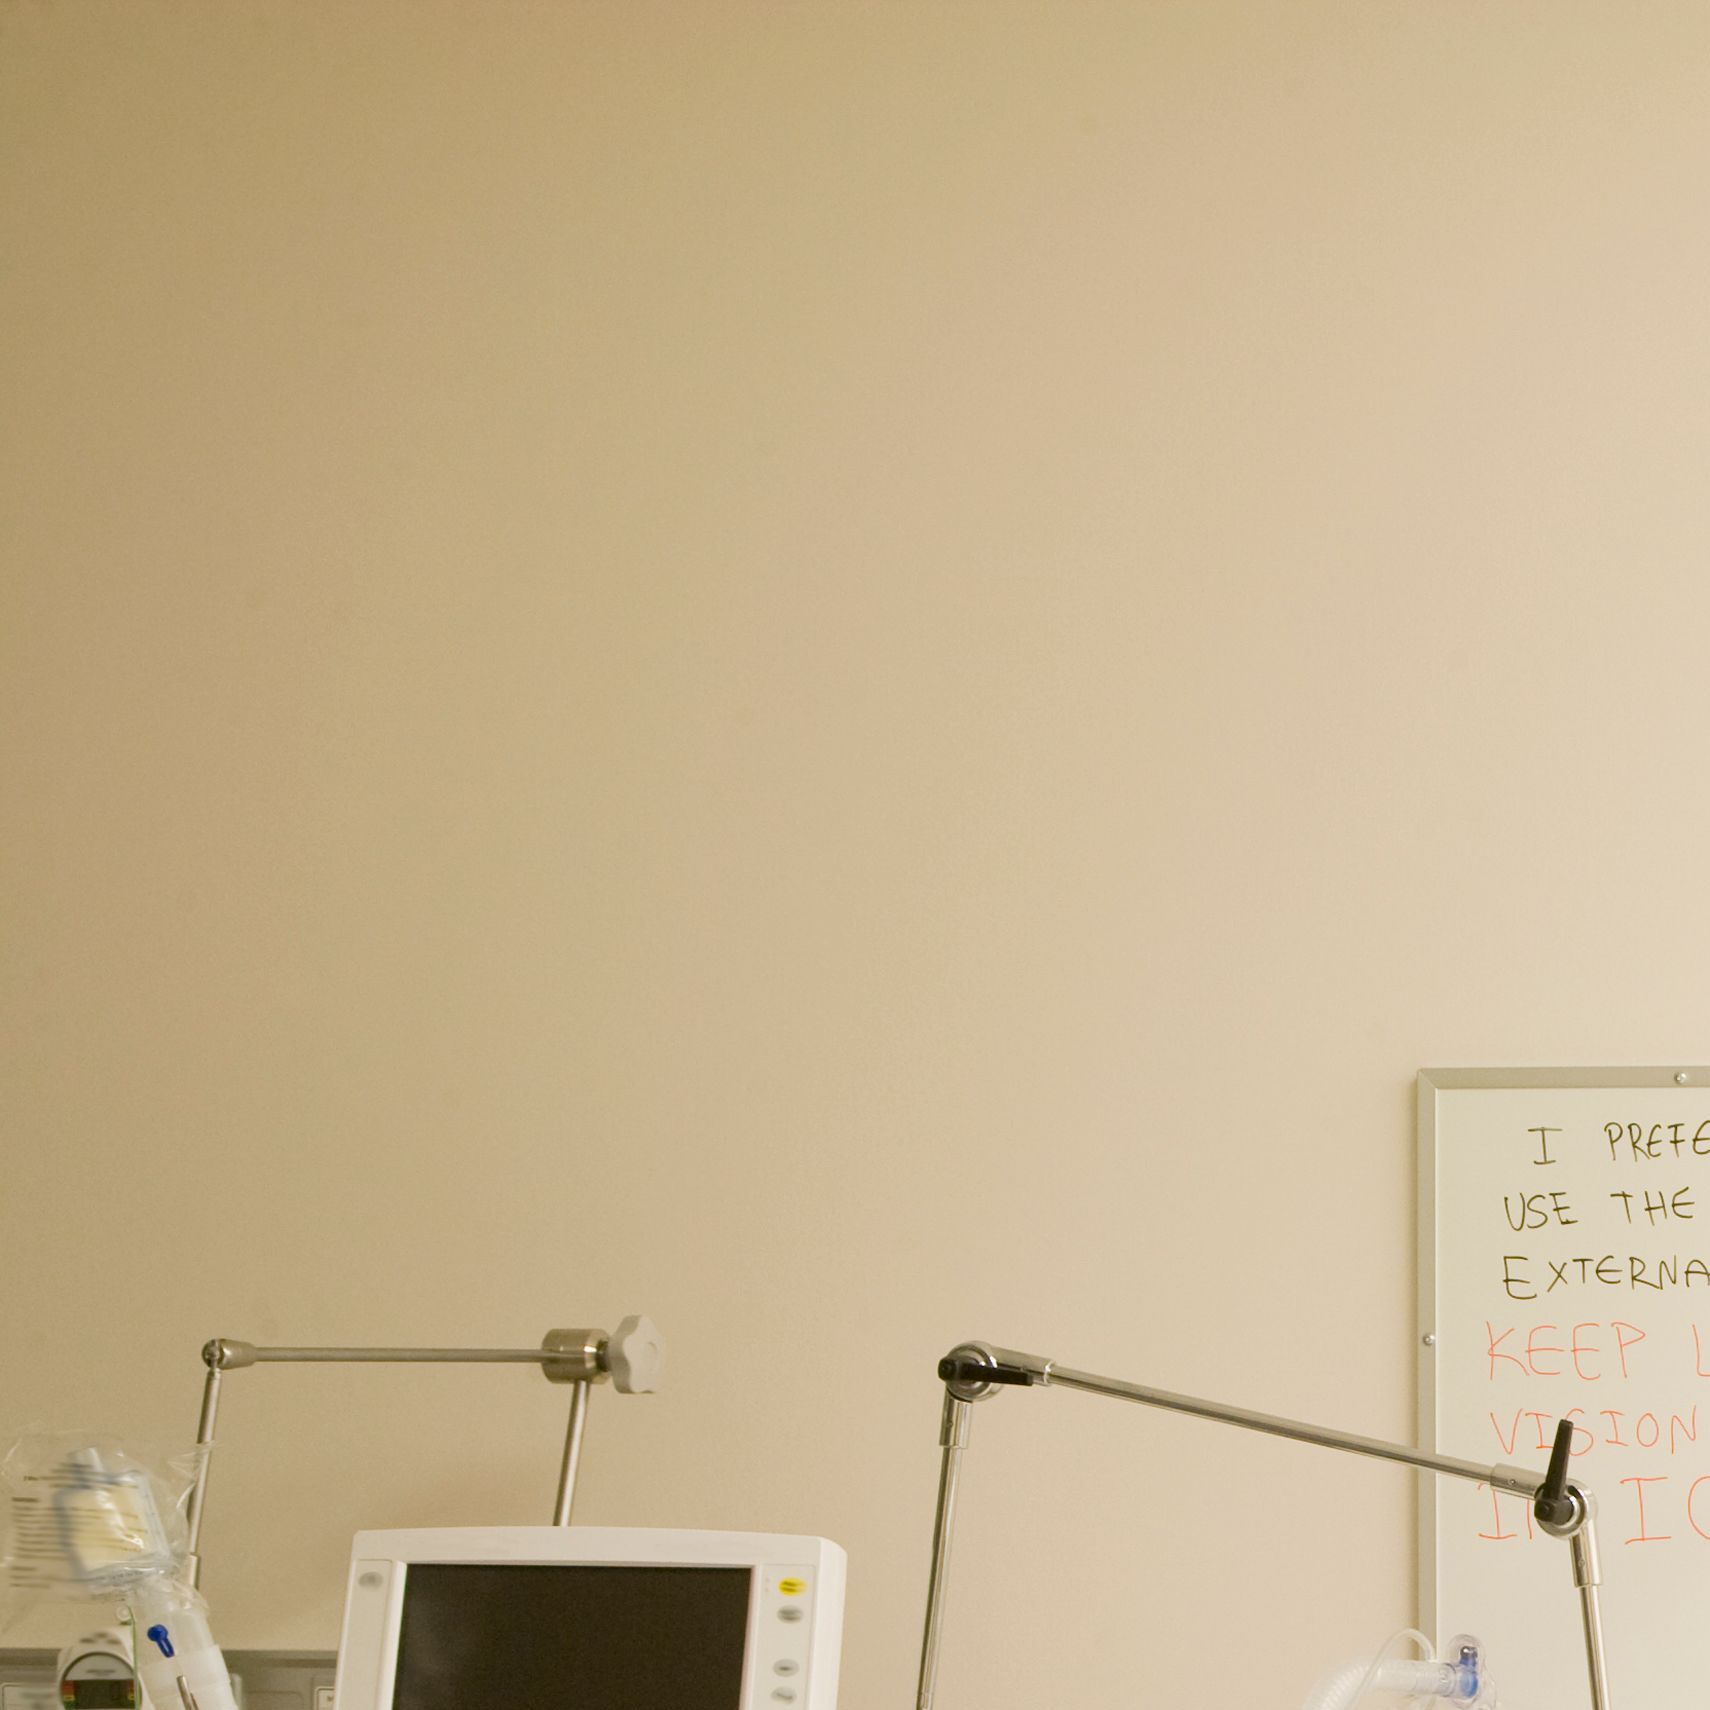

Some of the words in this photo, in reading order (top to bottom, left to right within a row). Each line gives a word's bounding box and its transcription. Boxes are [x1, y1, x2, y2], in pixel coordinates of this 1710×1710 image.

[1528, 1127, 1563, 1166] I
[1503, 1192, 1580, 1232] USE
[1610, 1186, 1696, 1227] THE
[1486, 1320, 1647, 1381] KEEP
